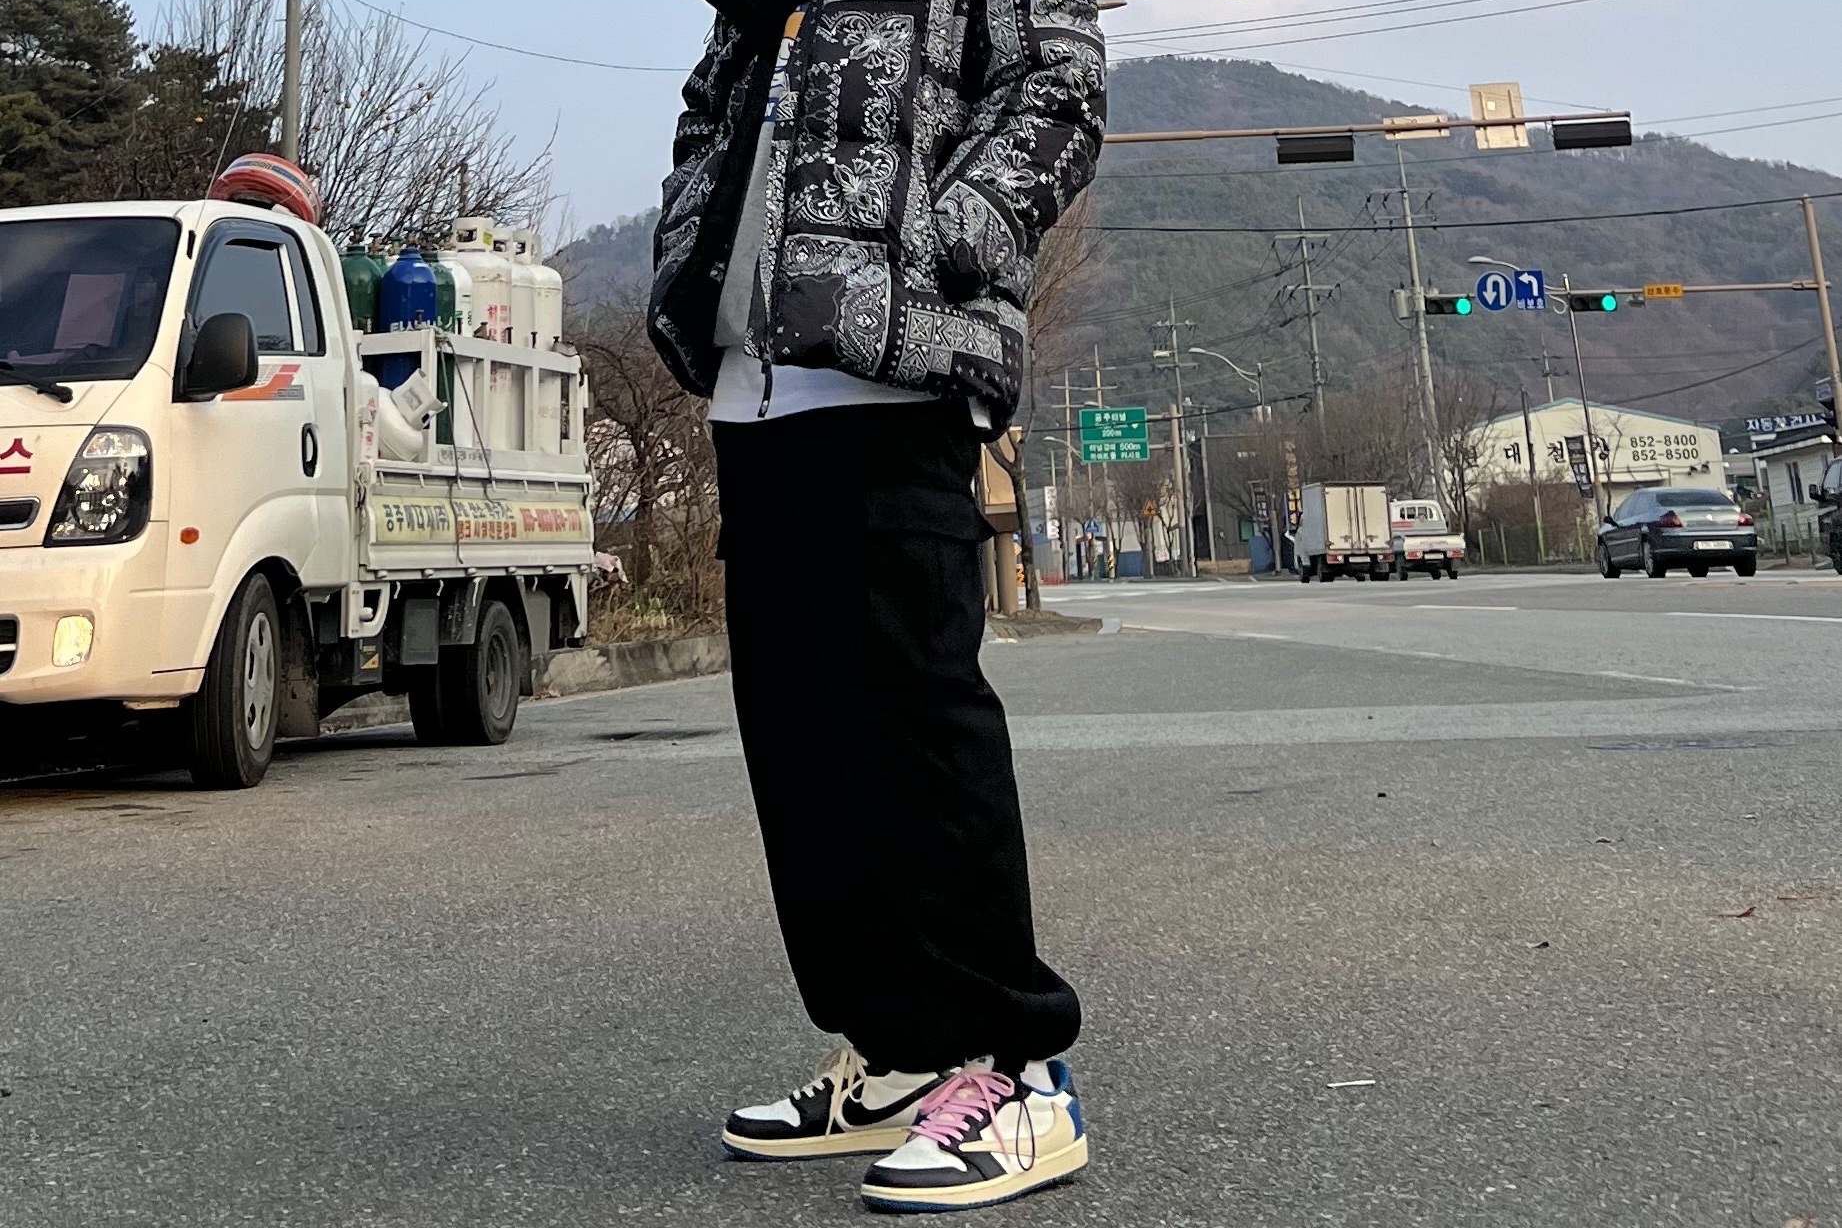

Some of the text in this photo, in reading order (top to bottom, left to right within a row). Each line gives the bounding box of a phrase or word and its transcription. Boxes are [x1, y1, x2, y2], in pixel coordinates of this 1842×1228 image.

[1517, 298, 1545, 309] 비보호
[1095, 412, 1126, 422] 공주터널
[1102, 429, 1122, 438] 200m
[1630, 434, 1697, 448] 852-8400
[1632, 448, 1699, 461] 852-8500
